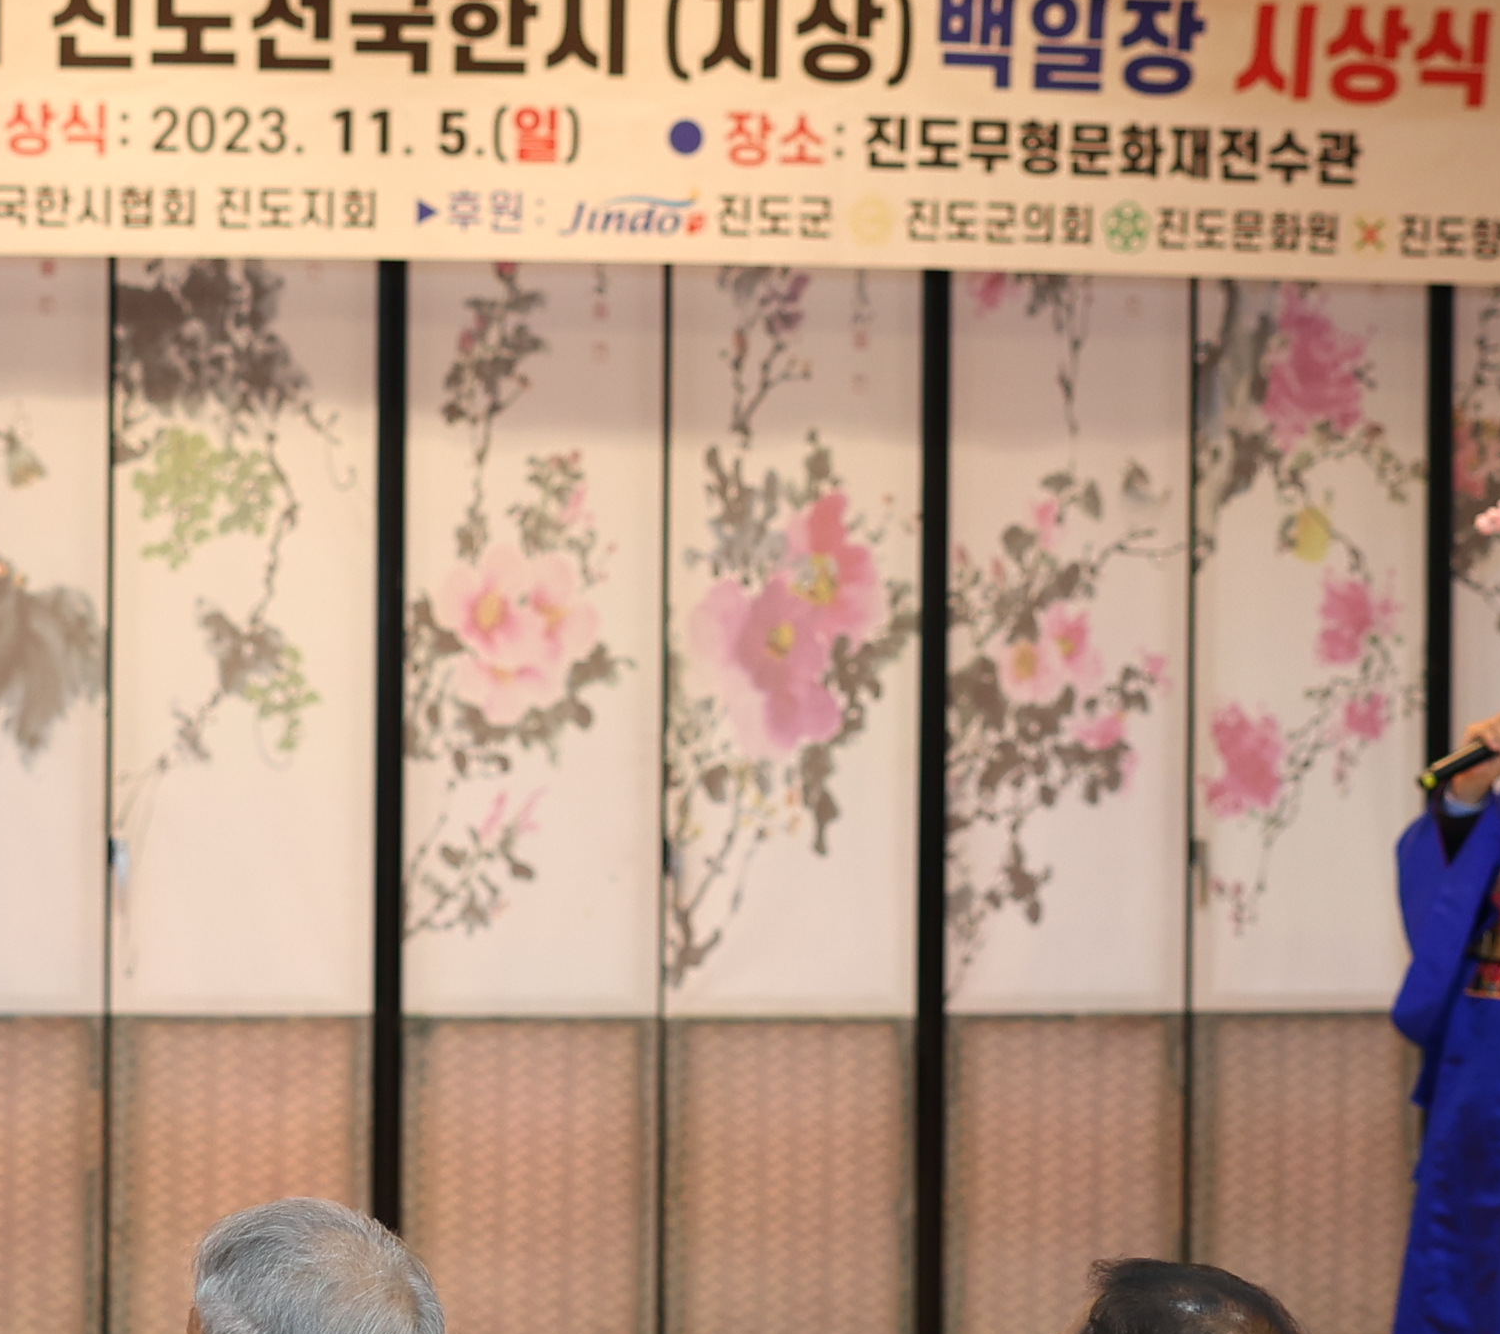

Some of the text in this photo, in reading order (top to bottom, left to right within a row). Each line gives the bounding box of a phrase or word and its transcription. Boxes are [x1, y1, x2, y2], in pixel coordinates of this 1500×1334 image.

[1235, 2, 1493, 110] 시상식
[152, 106, 305, 156] 2023.
[332, 108, 414, 157] 11.
[728, 112, 1364, 189] 장소: 진도무형문화재전수관
[218, 188, 378, 231] 진도지회
[718, 194, 834, 240] 진도군
[906, 199, 1096, 247] 진도군의회
[1157, 207, 1341, 256] 진도문화원
